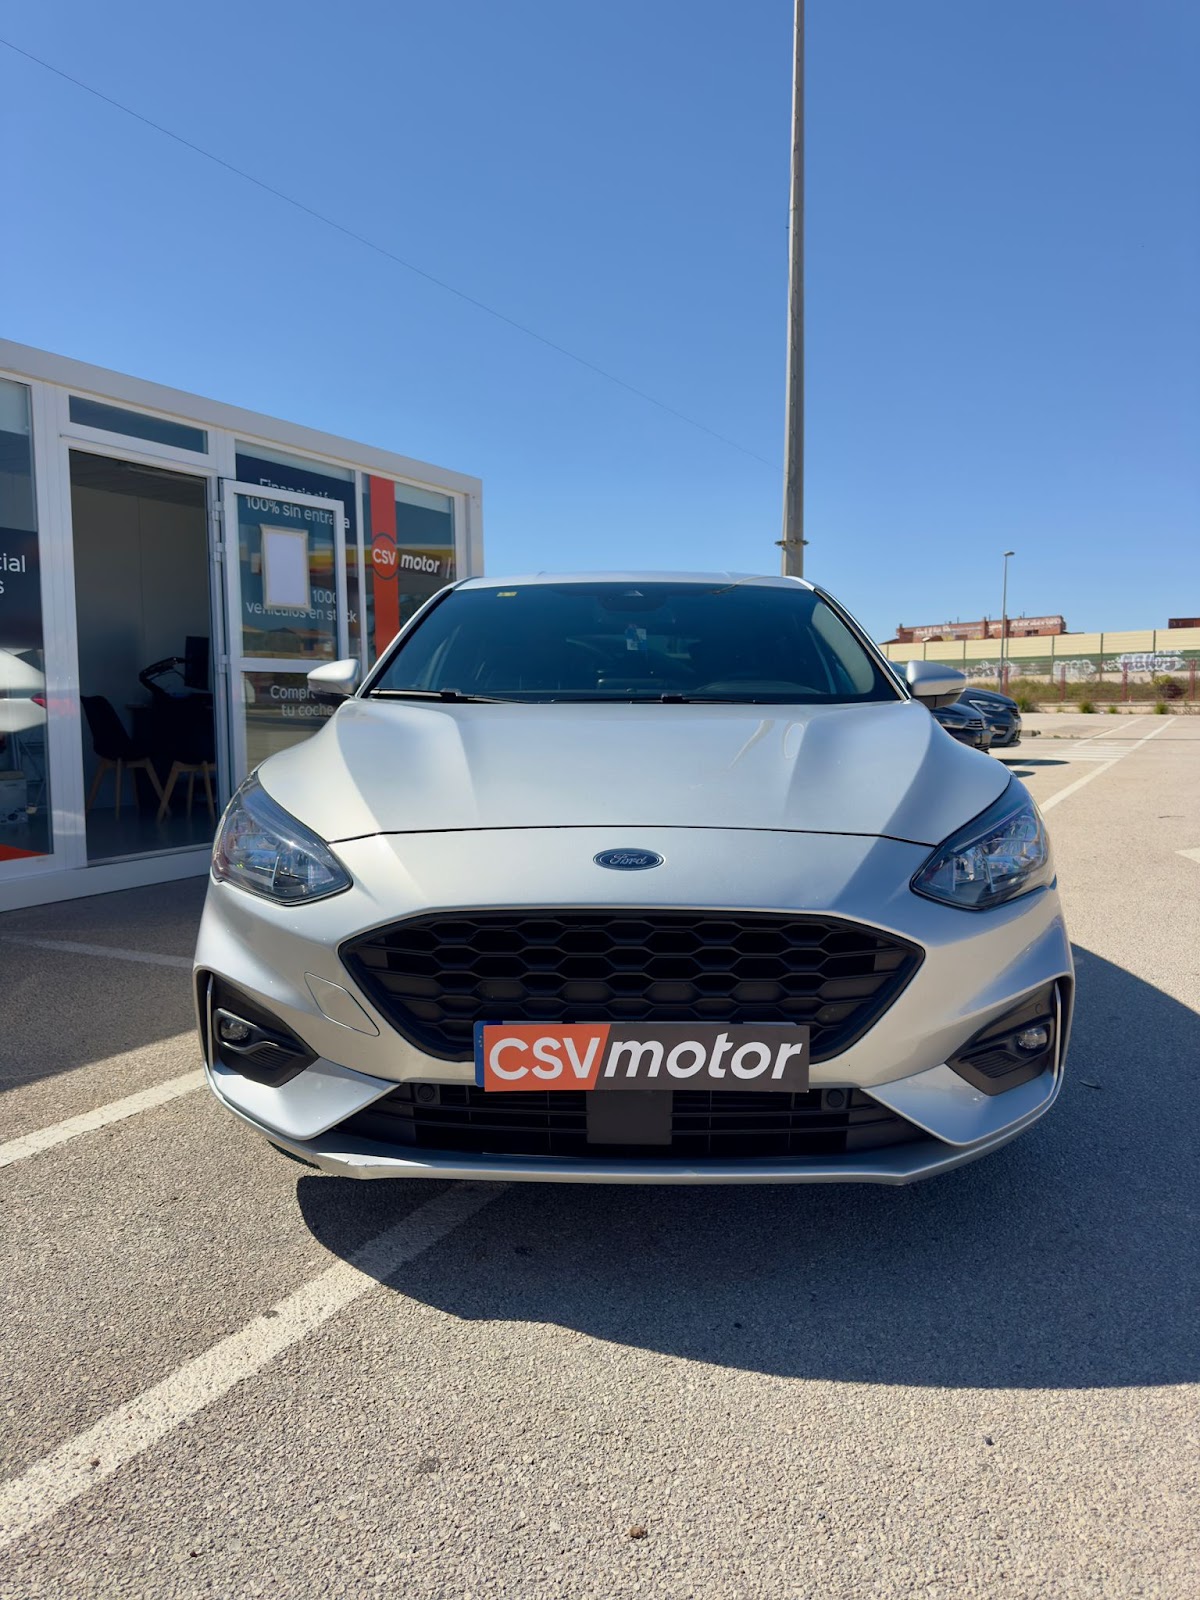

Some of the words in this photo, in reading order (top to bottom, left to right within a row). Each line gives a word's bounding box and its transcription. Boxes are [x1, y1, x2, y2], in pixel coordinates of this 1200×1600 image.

[246, 496, 280, 514] 100%
[283, 504, 301, 518] sin
[304, 509, 350, 529] entraa
[0, 553, 26, 573] ial
[372, 548, 396, 566] CSV
[401, 554, 440, 573] motor
[309, 609, 326, 620] en
[281, 704, 295, 716] tu
[298, 703, 334, 716] coche
[610, 853, 648, 865] Ford
